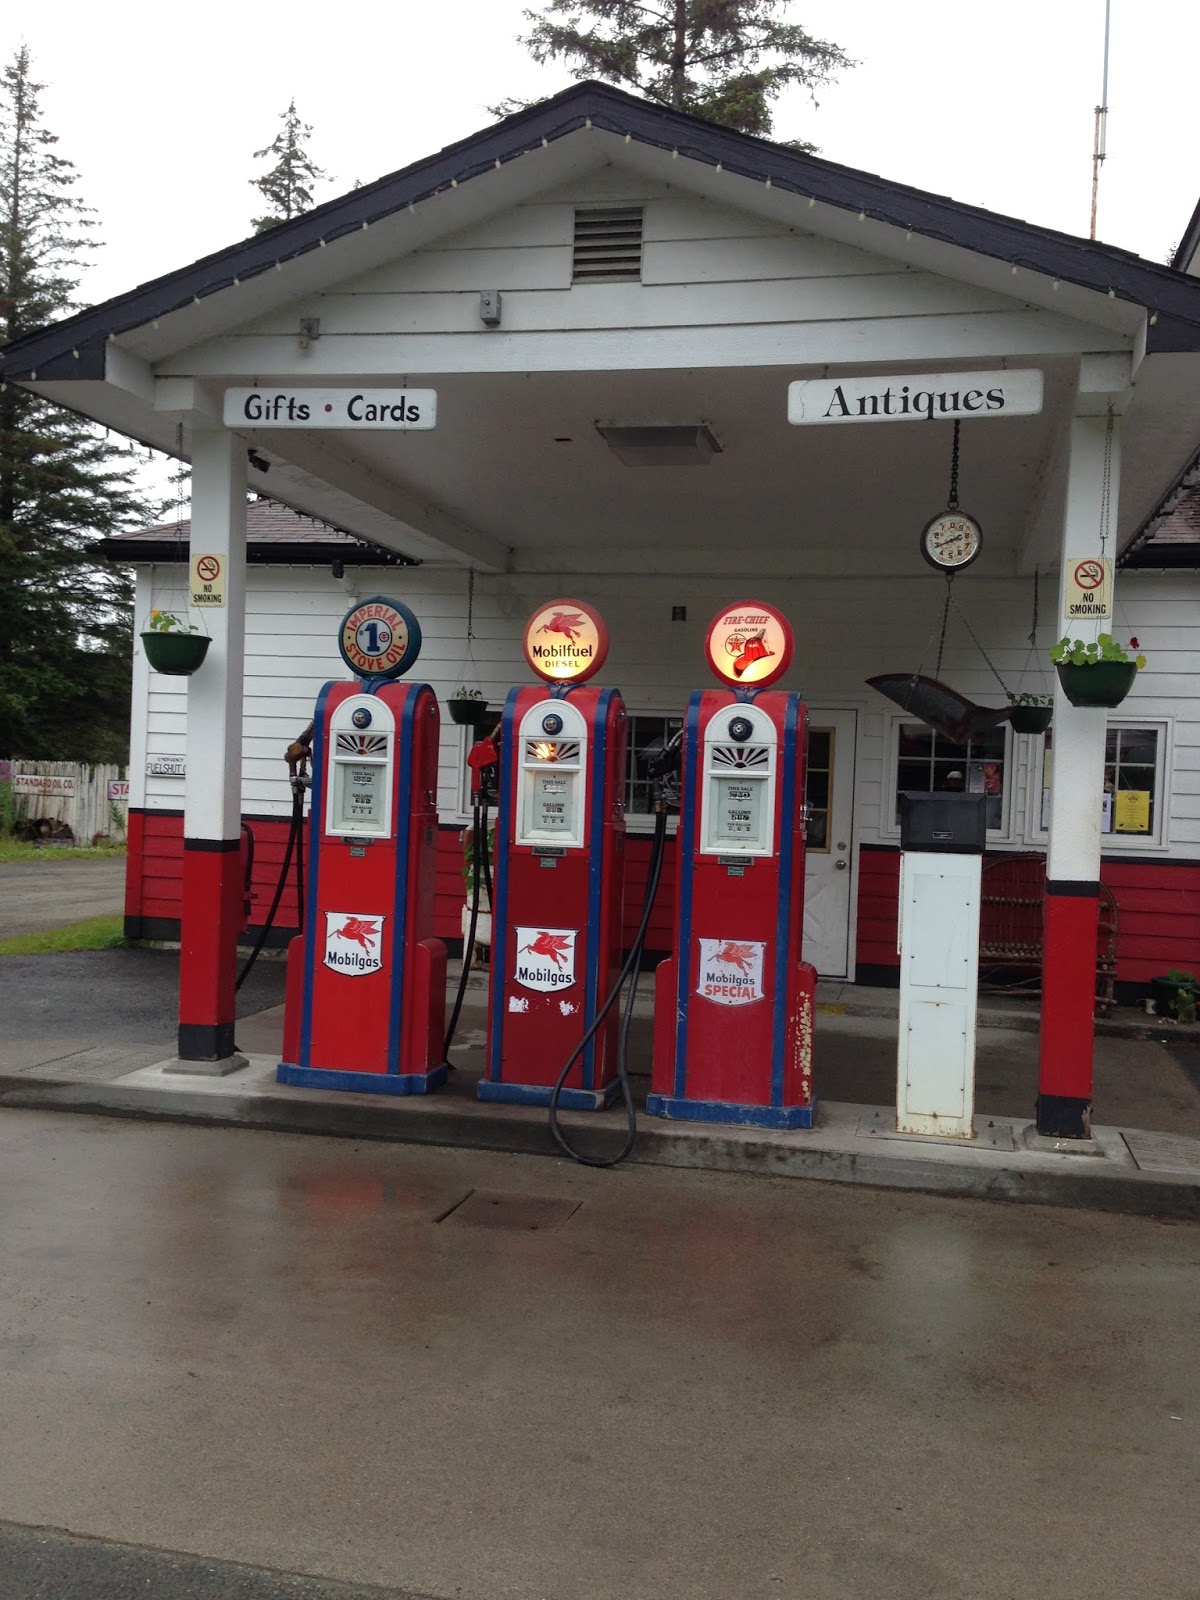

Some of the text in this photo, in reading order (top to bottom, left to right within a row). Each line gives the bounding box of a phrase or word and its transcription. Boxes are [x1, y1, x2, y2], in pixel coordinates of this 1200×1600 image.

[244, 394, 420, 422] Gifts Cards
[822, 385, 1005, 420] Antiques
[203, 584, 213, 593] NO
[193, 594, 222, 603] SMOKING
[1082, 593, 1094, 603] NO
[1070, 604, 1107, 614] SMOKING
[346, 605, 403, 632] IMPERIAL
[723, 615, 770, 625] FIRE-CHIEF
[346, 643, 406, 670] STOVE OIL
[533, 645, 592, 658] Mobilfuel
[146, 763, 161, 773] FUEL
[163, 764, 182, 774] SHUT
[15, 777, 51, 787] STANDARD
[327, 951, 379, 970] Mobilgas
[518, 967, 572, 986] Mobilgas
[706, 972, 755, 986] Mobilgas
[704, 984, 757, 999] SPECIAL
